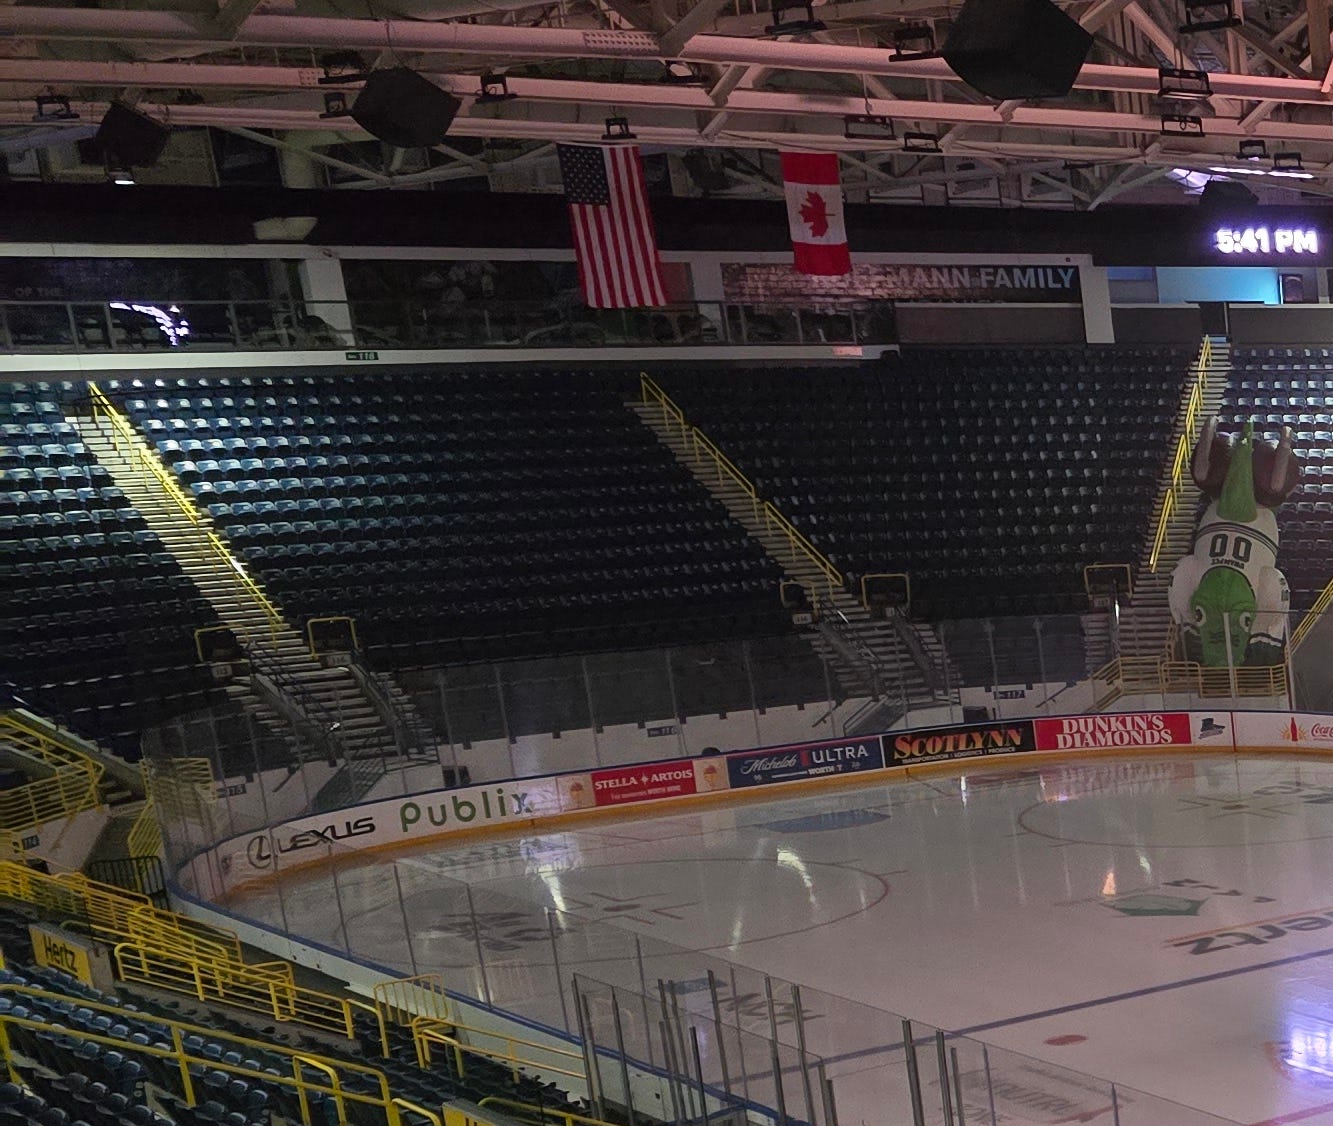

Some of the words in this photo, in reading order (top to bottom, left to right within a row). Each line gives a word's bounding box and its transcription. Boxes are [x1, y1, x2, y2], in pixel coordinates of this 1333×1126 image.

[1216, 227, 1270, 253] 5:41
[1275, 228, 1318, 253] PM
[980, 267, 1074, 290] FAMILY
[1209, 533, 1253, 563] 00
[1056, 728, 1172, 749] DIAMONDS
[1062, 713, 1165, 737] DUNKIN'S
[740, 753, 799, 774] Michelob
[812, 744, 869, 763] ULTRA
[894, 728, 1022, 760] SCOTLYNN
[594, 776, 639, 790] STELLA
[651, 768, 693, 783] ARTOIS
[400, 787, 533, 833] Publix
[277, 816, 376, 853] LEXUS
[44, 936, 76, 973] Hertz
